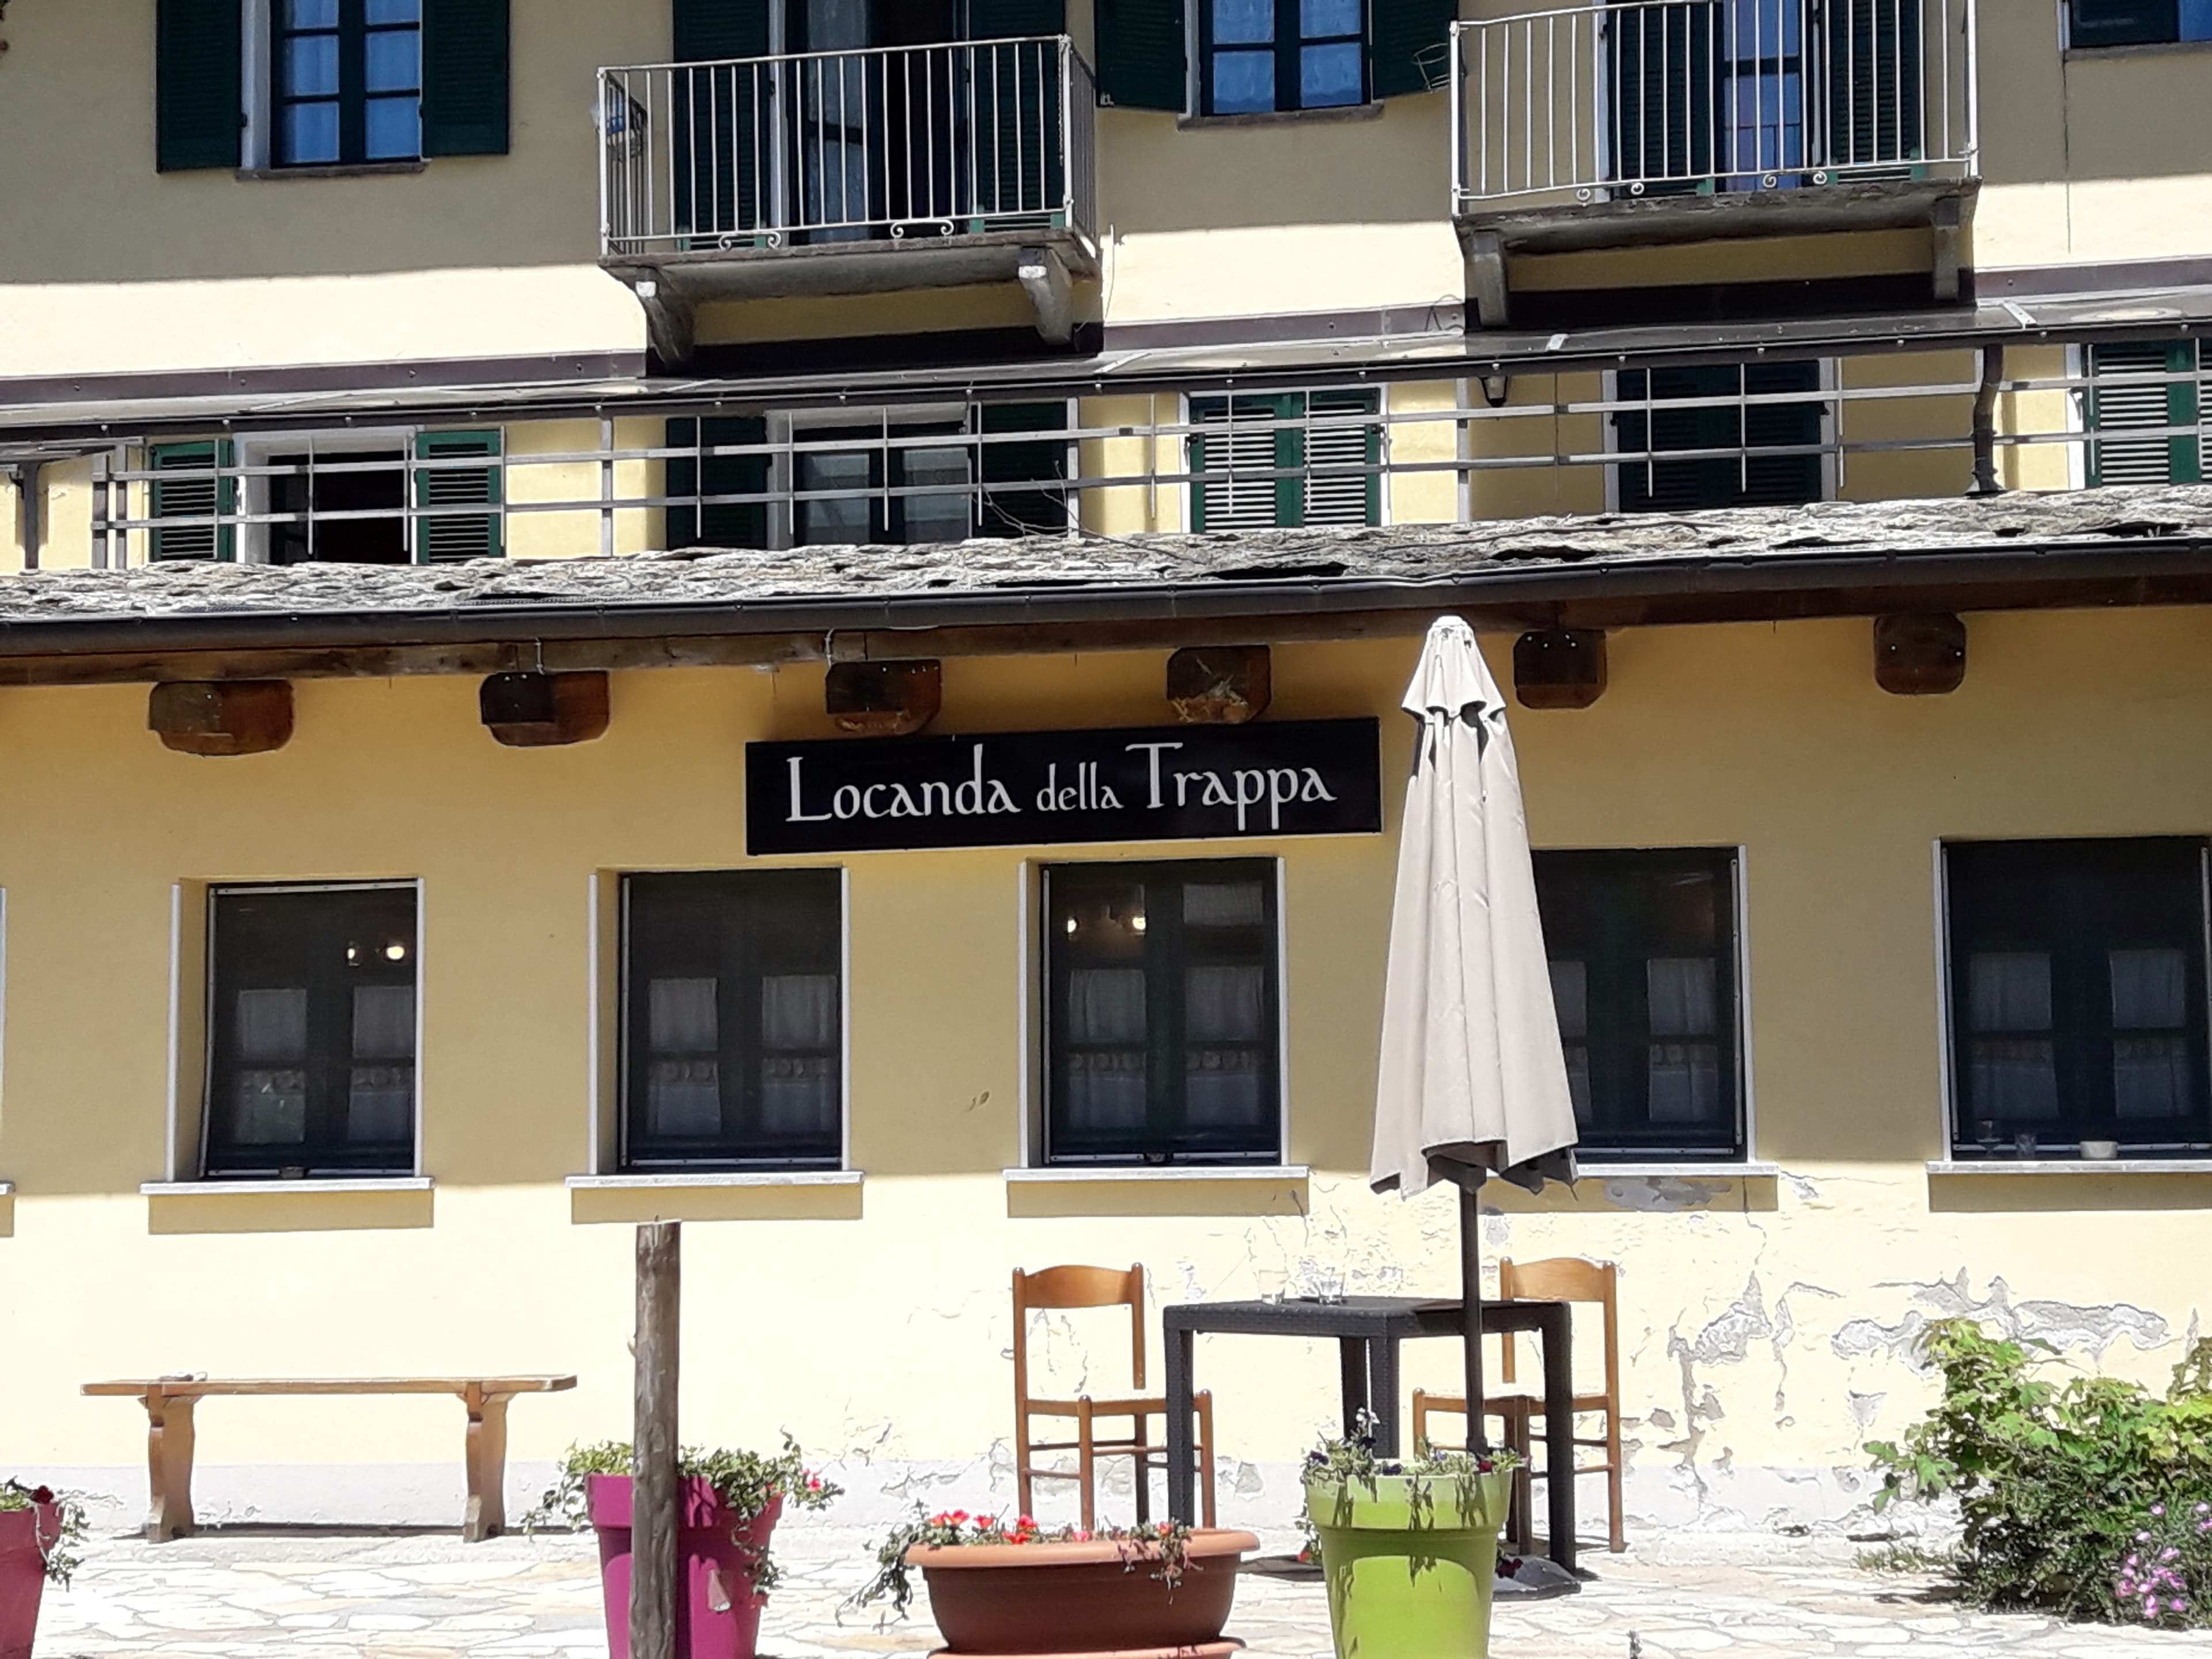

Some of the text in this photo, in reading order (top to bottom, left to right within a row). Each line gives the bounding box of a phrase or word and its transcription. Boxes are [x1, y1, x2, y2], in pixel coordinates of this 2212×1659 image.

[785, 742, 1337, 831] Locanda della Trappa
